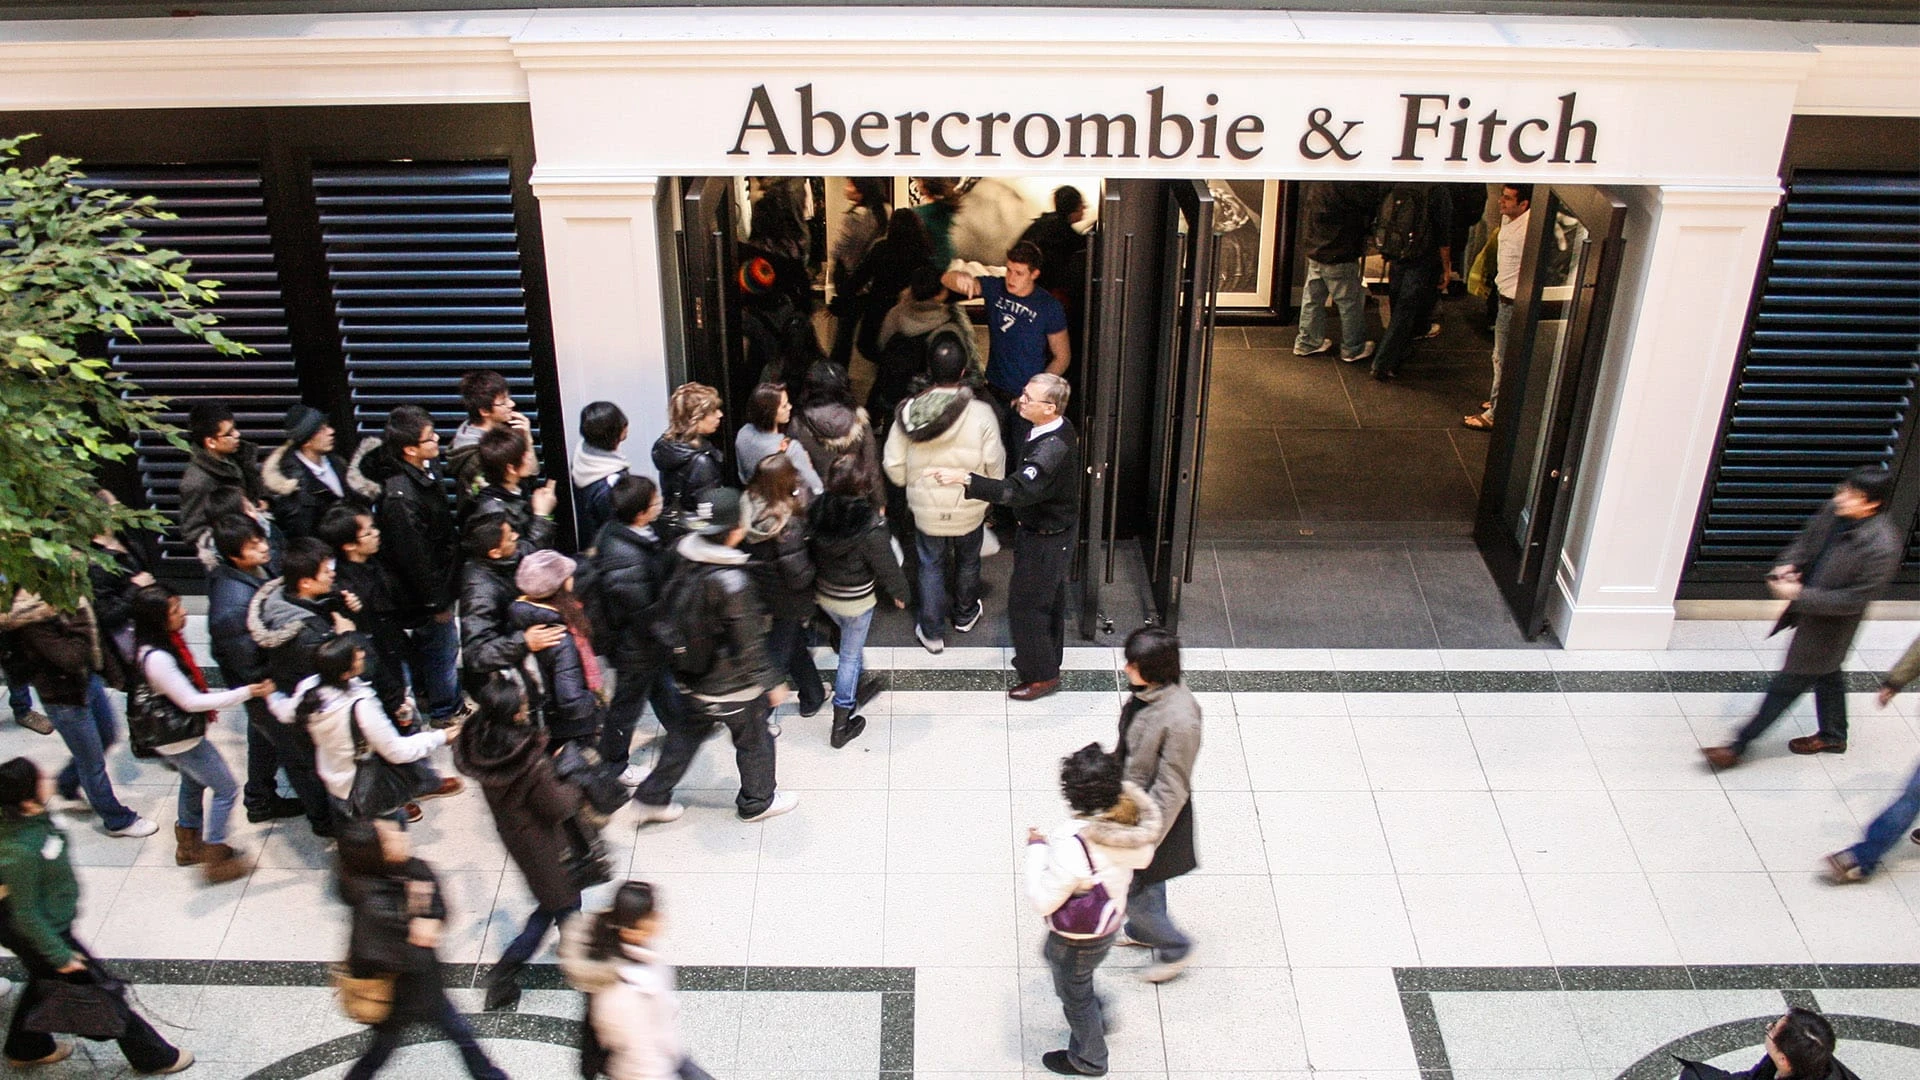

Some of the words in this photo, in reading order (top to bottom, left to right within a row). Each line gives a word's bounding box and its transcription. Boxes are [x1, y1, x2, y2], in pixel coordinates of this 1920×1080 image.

[727, 83, 1264, 160] Abercrombie
[1300, 107, 1363, 160] &
[1391, 91, 1598, 164] Fitch
